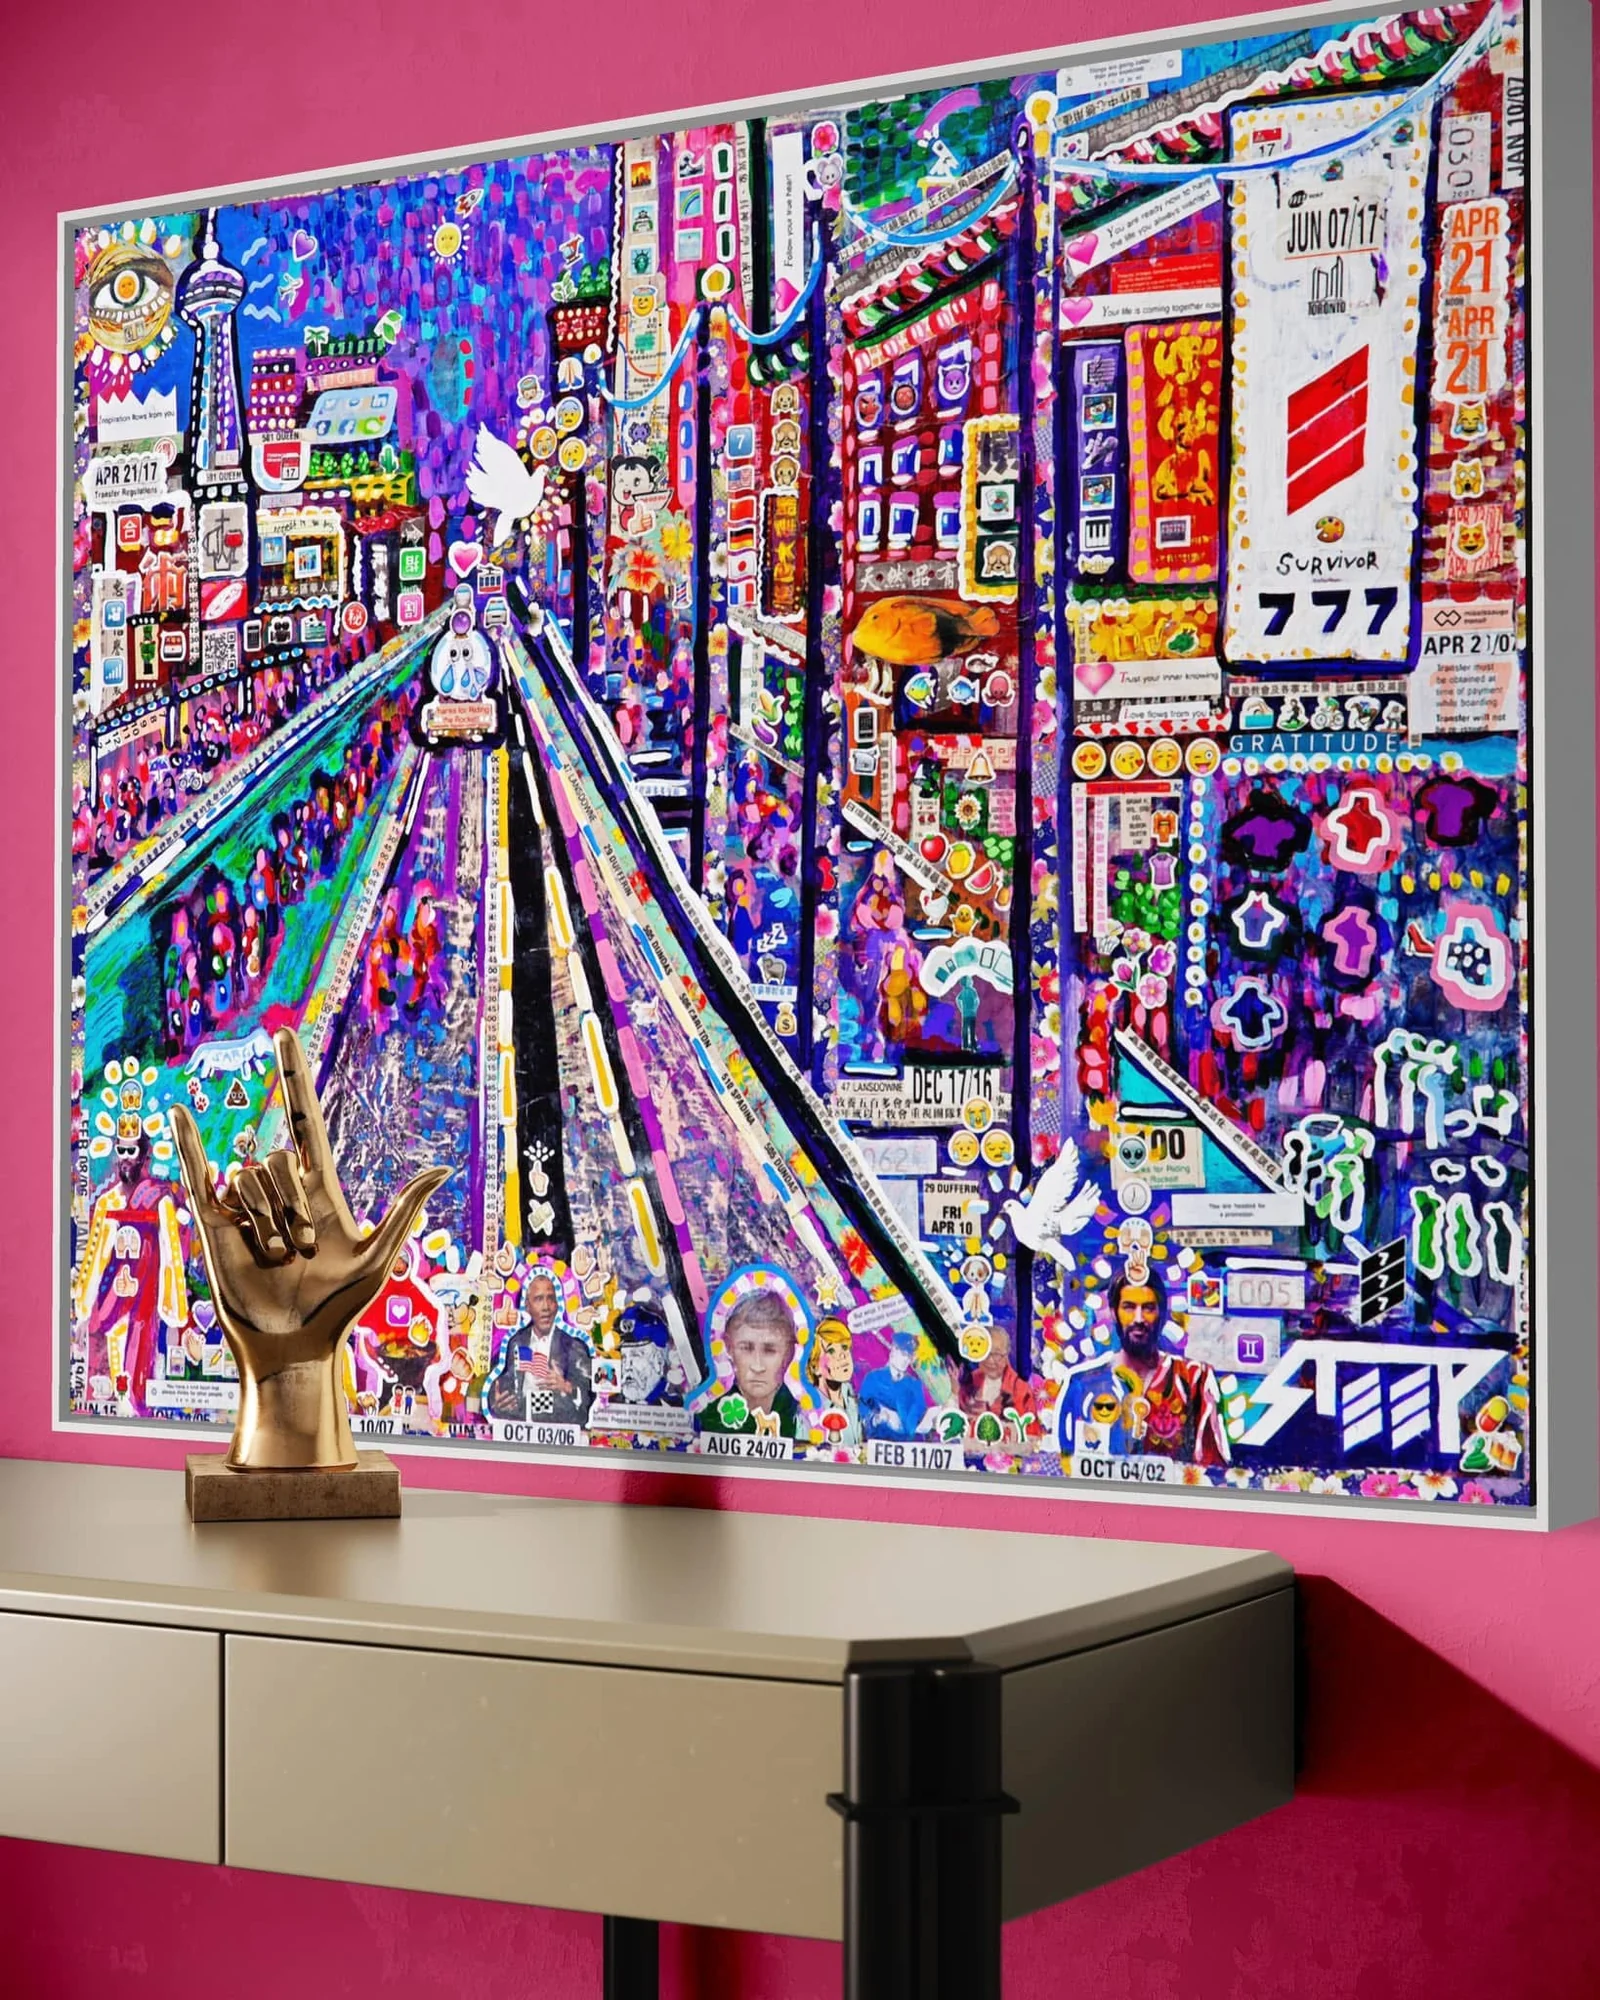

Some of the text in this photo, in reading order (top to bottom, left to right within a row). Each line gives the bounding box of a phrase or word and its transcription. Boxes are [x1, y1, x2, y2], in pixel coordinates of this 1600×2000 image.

[1507, 77, 1524, 177] JAN 10/07
[1259, 143, 1275, 157] 17
[1106, 225, 1124, 238] You
[1288, 201, 1378, 253] JUN 07/17
[1452, 207, 1500, 238] APR
[784, 238, 794, 267] Follow
[1449, 240, 1493, 295] 21
[1102, 305, 1120, 317] Your
[1308, 301, 1346, 316] TORONTO
[1447, 306, 1495, 337] APR
[1446, 340, 1489, 395] 21
[276, 432, 299, 442] QUEEN
[735, 434, 746, 450] 7
[95, 462, 158, 486] APR 21/17
[218, 470, 242, 482] QUEEN
[286, 468, 296, 477] 17
[94, 487, 158, 499] Transfer Regulations
[124, 519, 138, 538] 合
[1424, 634, 1516, 656] APR 21/07
[1437, 663, 1494, 672] Transfer must
[1119, 671, 1141, 684] Trust
[1143, 672, 1160, 684] your
[1449, 675, 1485, 683] obtained
[1467, 687, 1503, 696] payment
[1460, 699, 1497, 708] boarding
[1436, 713, 1506, 722] Transfer will not
[1230, 733, 1400, 753] GRATITUDE
[568, 770, 598, 823] LANSDOWNE
[608, 854, 632, 897] DUFFERIN
[651, 939, 674, 976] DUNDAS
[689, 1009, 712, 1048] CARLTON
[840, 1081, 904, 1092] 47 LANSDOWNE
[913, 1068, 992, 1104] DEC 17/16
[731, 1086, 756, 1126] SPADINA
[773, 1156, 799, 1194] DUNDAS
[925, 1184, 979, 1194] 29 DUFFERIN
[942, 1206, 961, 1220] FRI
[931, 1222, 973, 1235] APR 10
[1378, 1275, 1389, 1289] 7
[1239, 1280, 1290, 1307] 005
[1378, 1297, 1389, 1311] 7
[360, 1419, 394, 1434] 10/07
[504, 1423, 575, 1445] OCT 03/06
[707, 1437, 787, 1459] AUG 24/07
[874, 1442, 951, 1468] FEB 11/07
[1080, 1458, 1165, 1482] OCT 04/02
